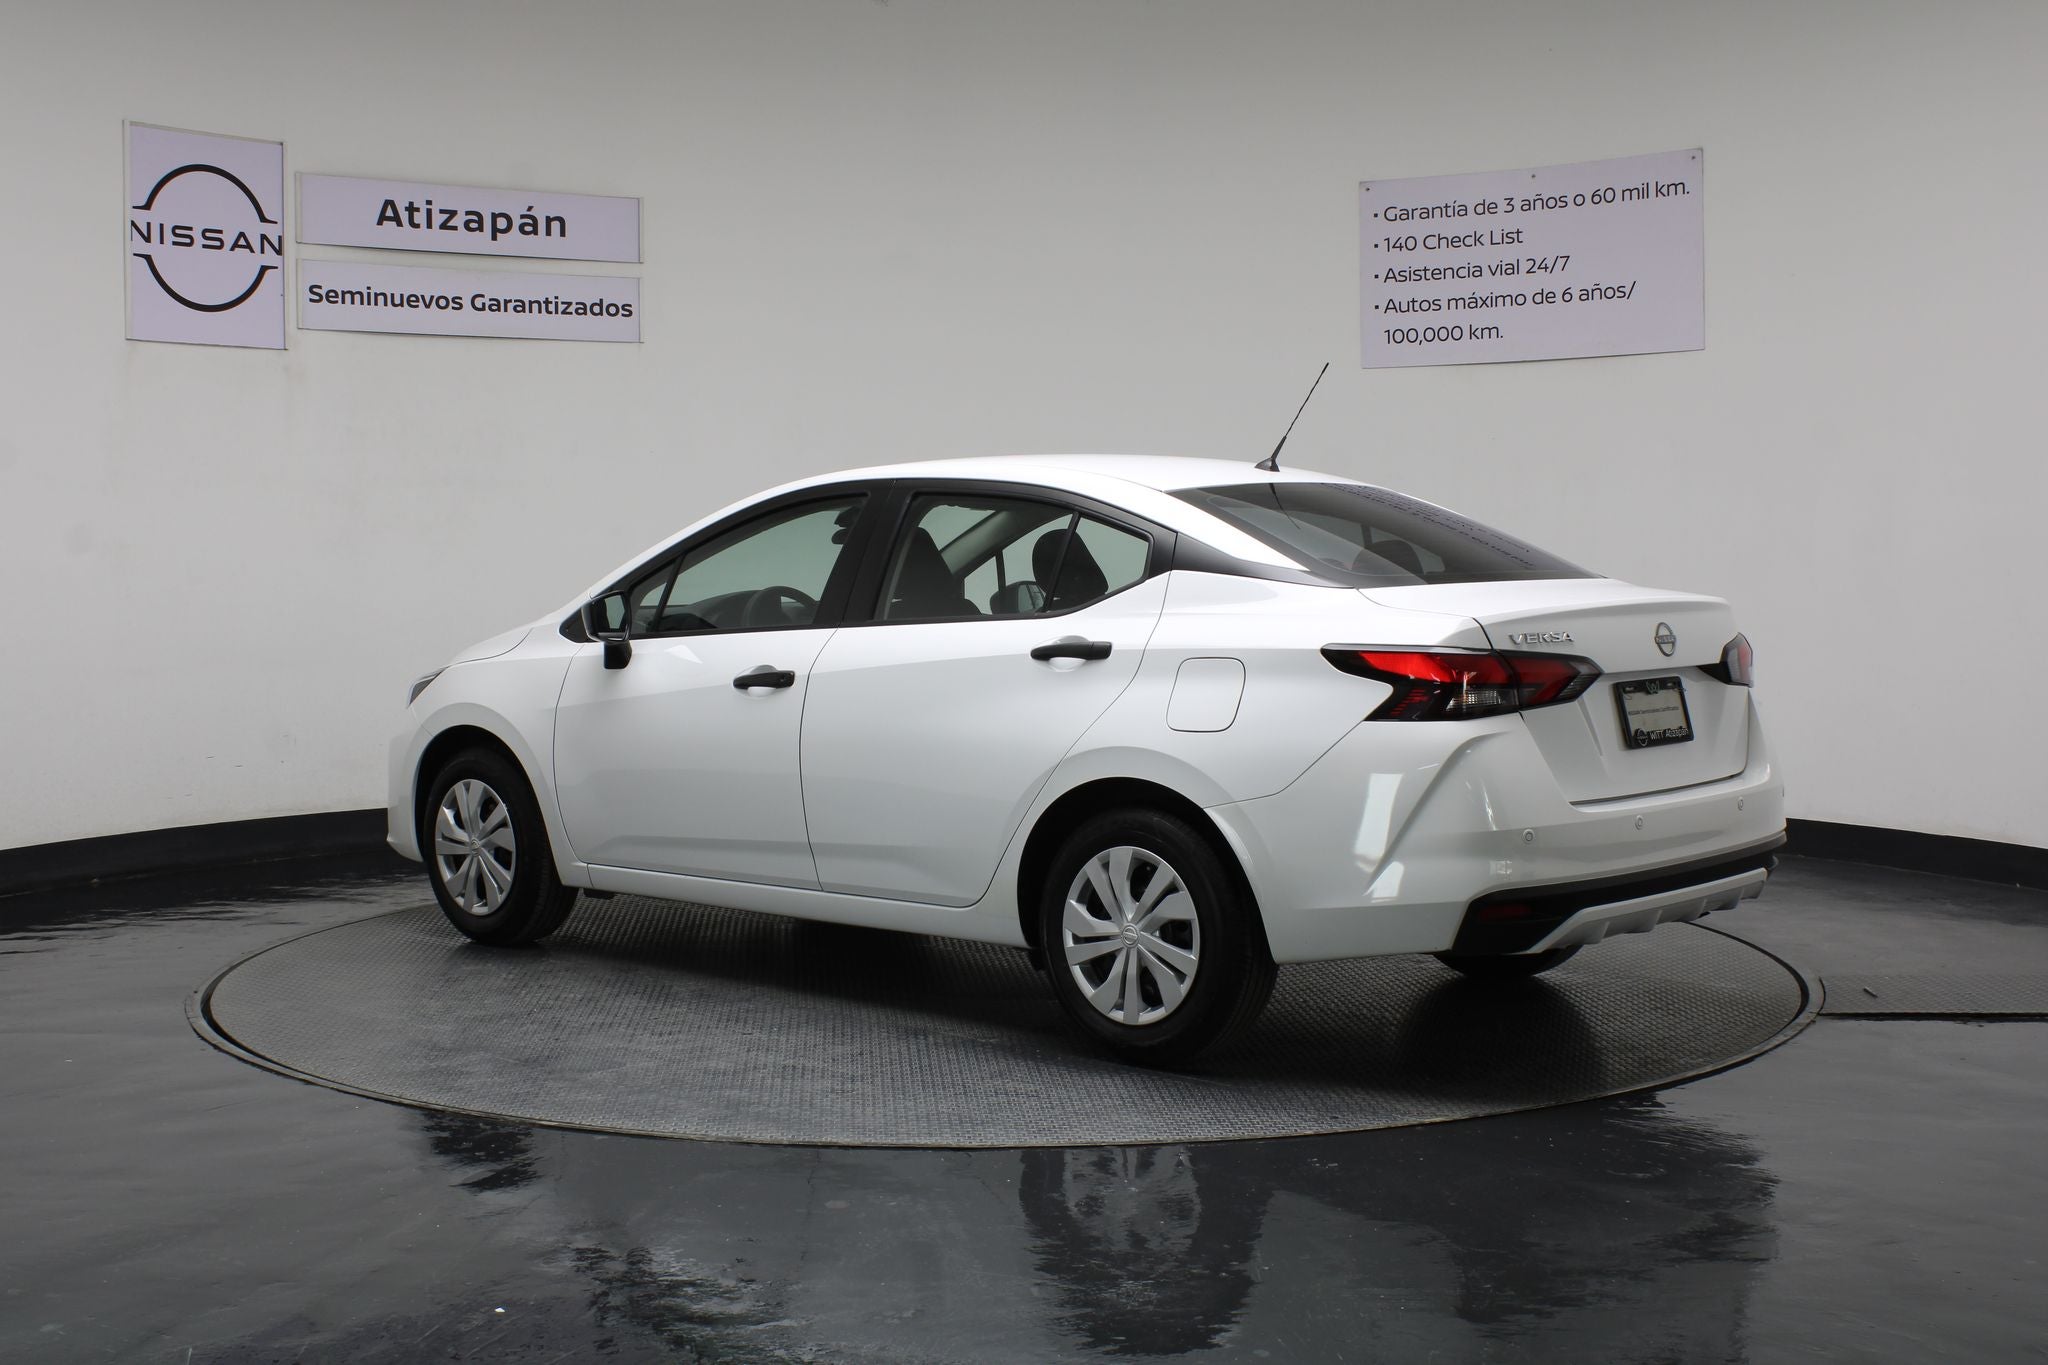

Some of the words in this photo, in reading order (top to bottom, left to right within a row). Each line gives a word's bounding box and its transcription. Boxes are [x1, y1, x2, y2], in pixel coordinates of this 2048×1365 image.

[1384, 200, 1467, 222] Garantía
[1474, 199, 1498, 215] de
[1504, 198, 1514, 213] 3
[1521, 194, 1568, 211] años
[1573, 194, 1585, 206] o
[1591, 187, 1616, 205] 60
[1622, 182, 1649, 201] mil
[1656, 181, 1689, 198] km.
[376, 199, 566, 240] Atizapán
[131, 220, 282, 256] NISSAN
[1384, 236, 1417, 252] 140
[1423, 231, 1484, 249] Check
[1490, 229, 1523, 245] List
[1384, 263, 1482, 283] Asistencia
[1488, 259, 1519, 276] vial
[1526, 256, 1570, 274] 24/7
[309, 285, 463, 310] Seminuevos
[471, 294, 633, 317] Garantizados
[1384, 298, 1441, 314] Autos
[1448, 292, 1526, 310] máximo
[1532, 288, 1556, 304] de
[1562, 287, 1573, 302] 6
[1579, 281, 1636, 301] años/
[1384, 326, 1463, 345] 100,000
[1470, 324, 1503, 340] km.
[1508, 631, 1574, 646] VERSA
